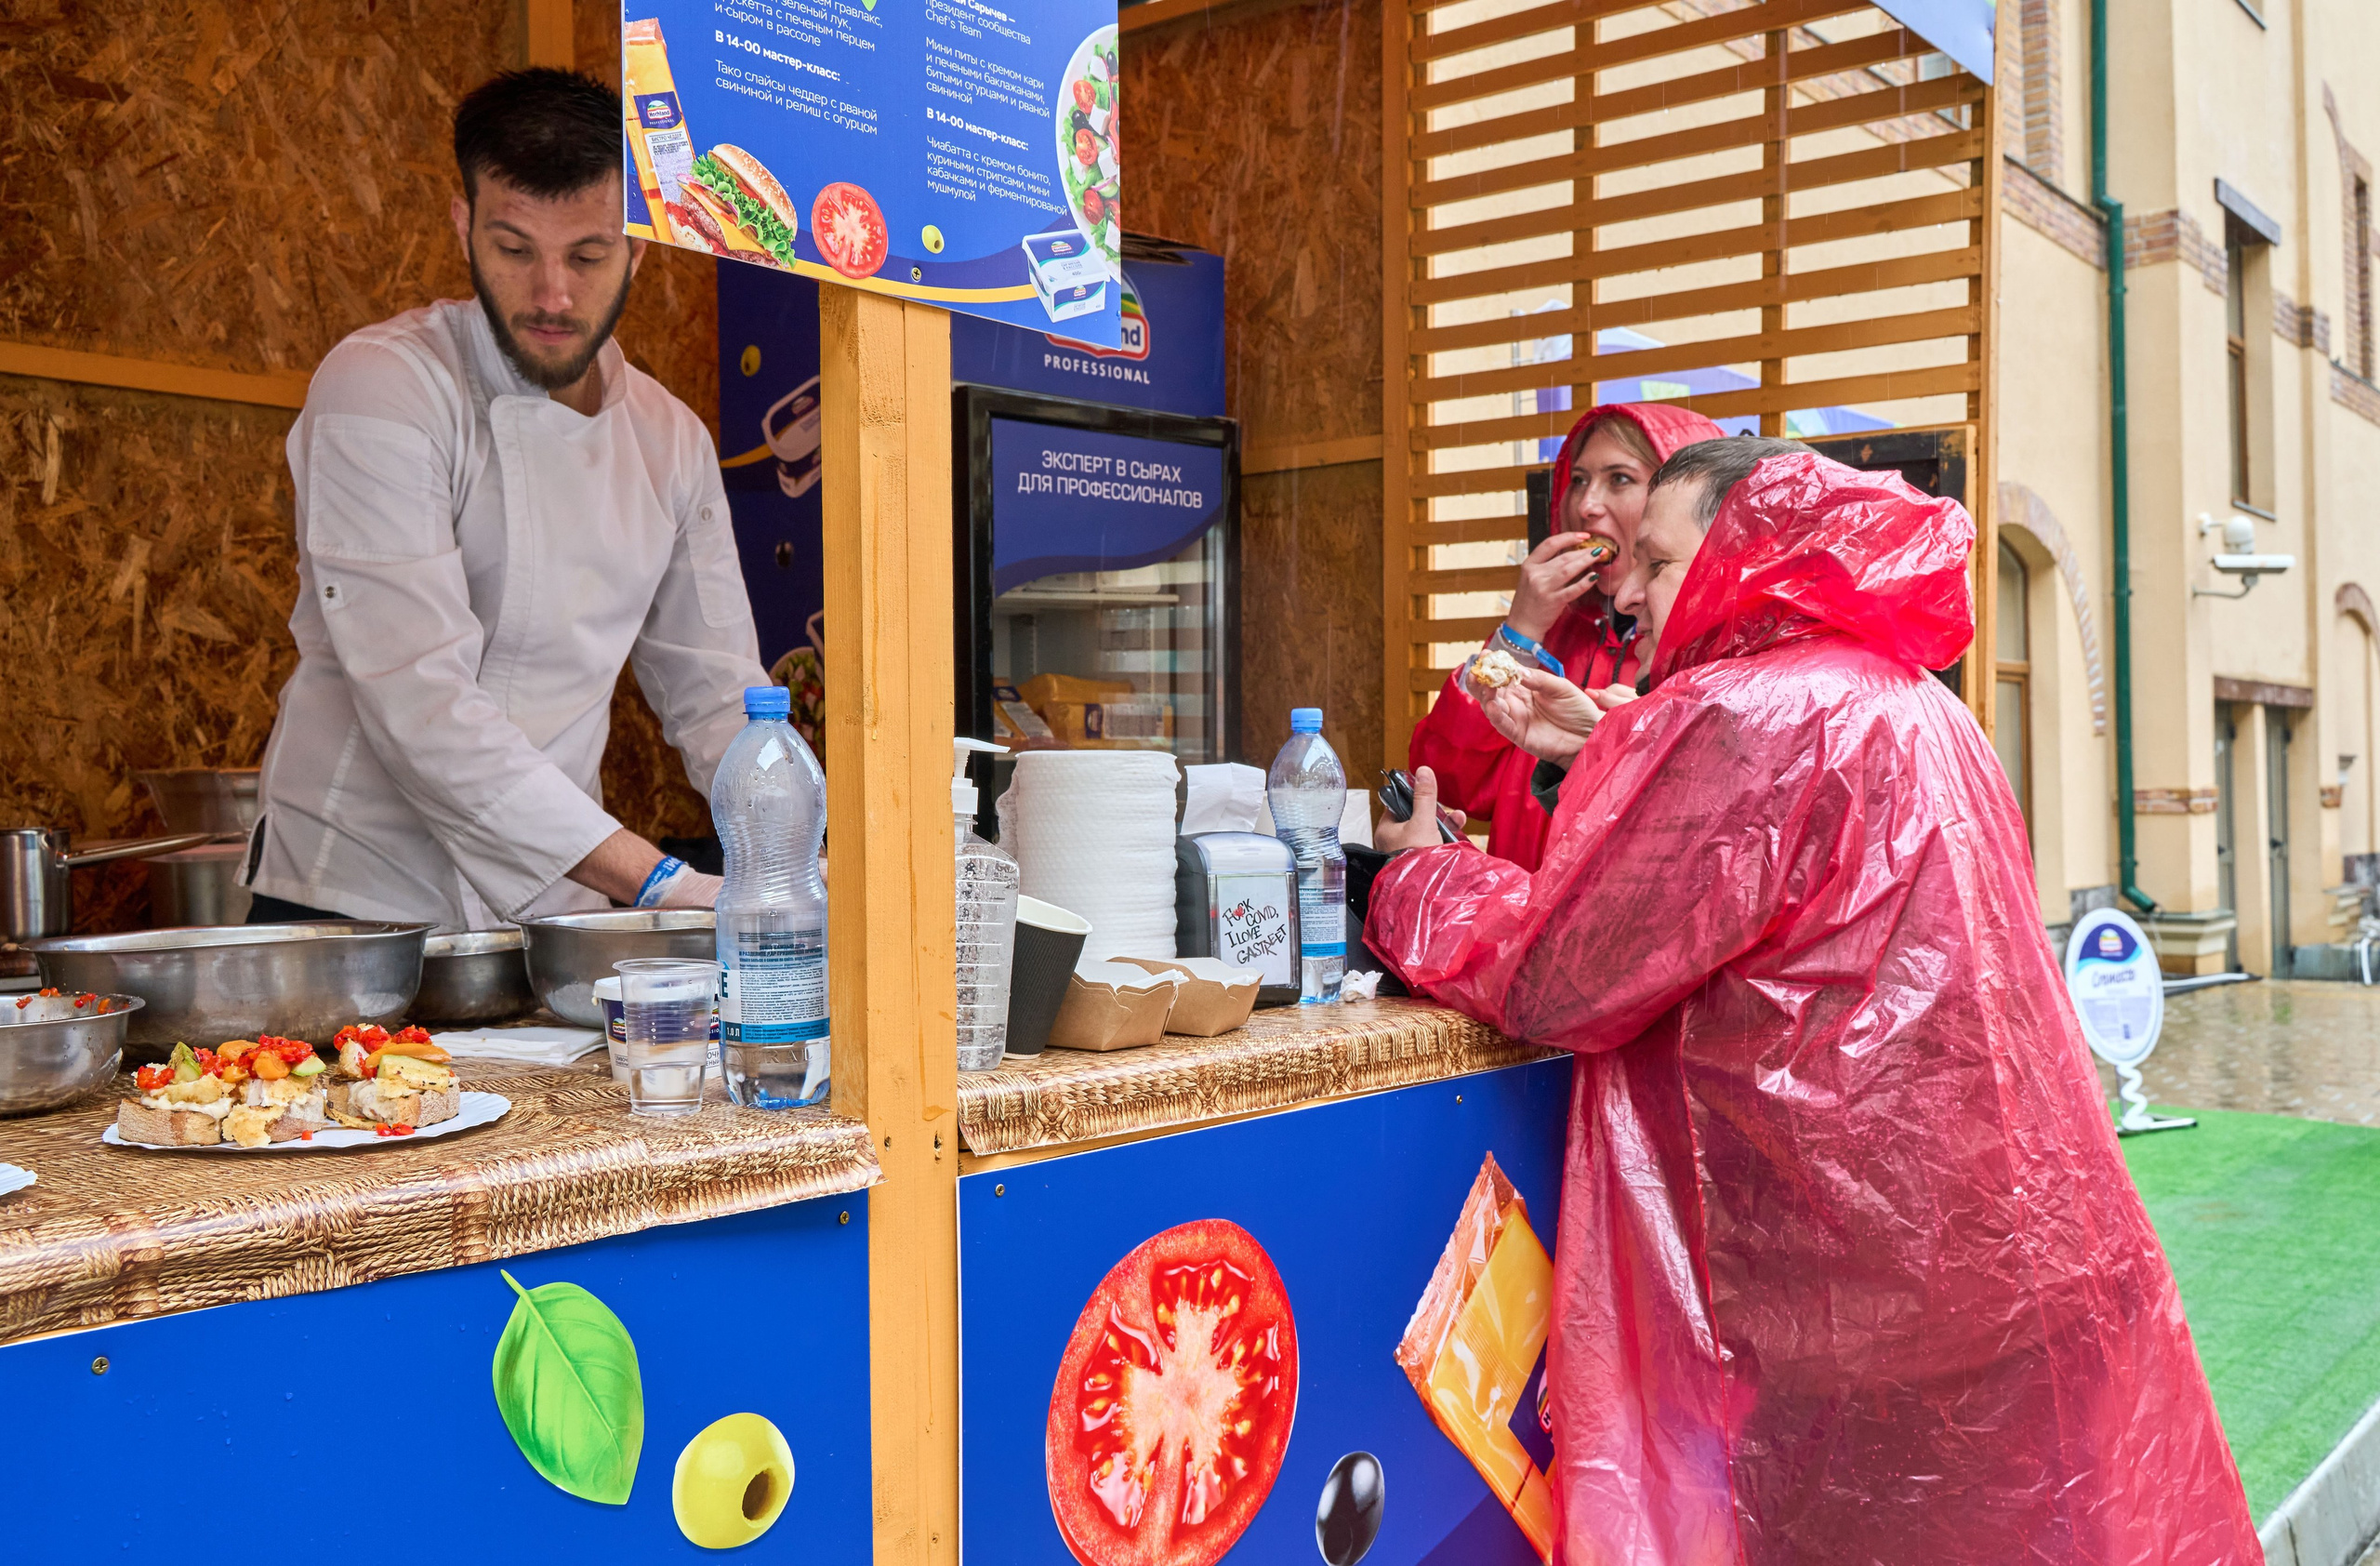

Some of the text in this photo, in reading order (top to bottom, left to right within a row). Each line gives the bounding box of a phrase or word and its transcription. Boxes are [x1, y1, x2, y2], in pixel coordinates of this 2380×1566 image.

[830, 15, 852, 31] лук,
[834, 3, 883, 29] гравлакс,
[925, 8, 982, 40] Chef's Team
[968, 0, 1008, 22] Сарычев
[767, 20, 774, 30] в
[776, 24, 821, 46] рассоле
[775, 11, 783, 20] с
[786, 12, 833, 37] печеным
[837, 30, 876, 52] перцем
[977, 17, 1031, 45] сообщества
[715, 30, 840, 81] В 14-00 мастер-класс:
[926, 37, 1044, 90] Мини питы с кремом кари
[715, 60, 878, 122] Тако слайсы чеддер с рваной
[926, 53, 1045, 104] и печеными баклажанами,
[926, 65, 1050, 118] битыми огурцами и рваной
[926, 82, 972, 104] свининой
[715, 77, 878, 136] свининой и релиш с огурцом
[927, 107, 1029, 151] В 14-00 мастер-класс:
[927, 135, 1051, 186] Чиабатта с кремом бонито,
[927, 152, 1050, 198] куриными стрипсами, мини
[927, 166, 1067, 216] кабачками и ферментированой
[927, 180, 976, 202] мушмулой
[1044, 354, 1151, 384] PROFESSIONAL
[1041, 450, 1182, 483] ЭКСПЕРТ В СЫРАХ
[1017, 472, 1202, 509] ДЛЯ ПРОФЕССИОНАЛОВ
[1246, 906, 1278, 927] COVID,
[1224, 925, 1263, 948] I LOVE
[1236, 923, 1287, 964] GASTREET
